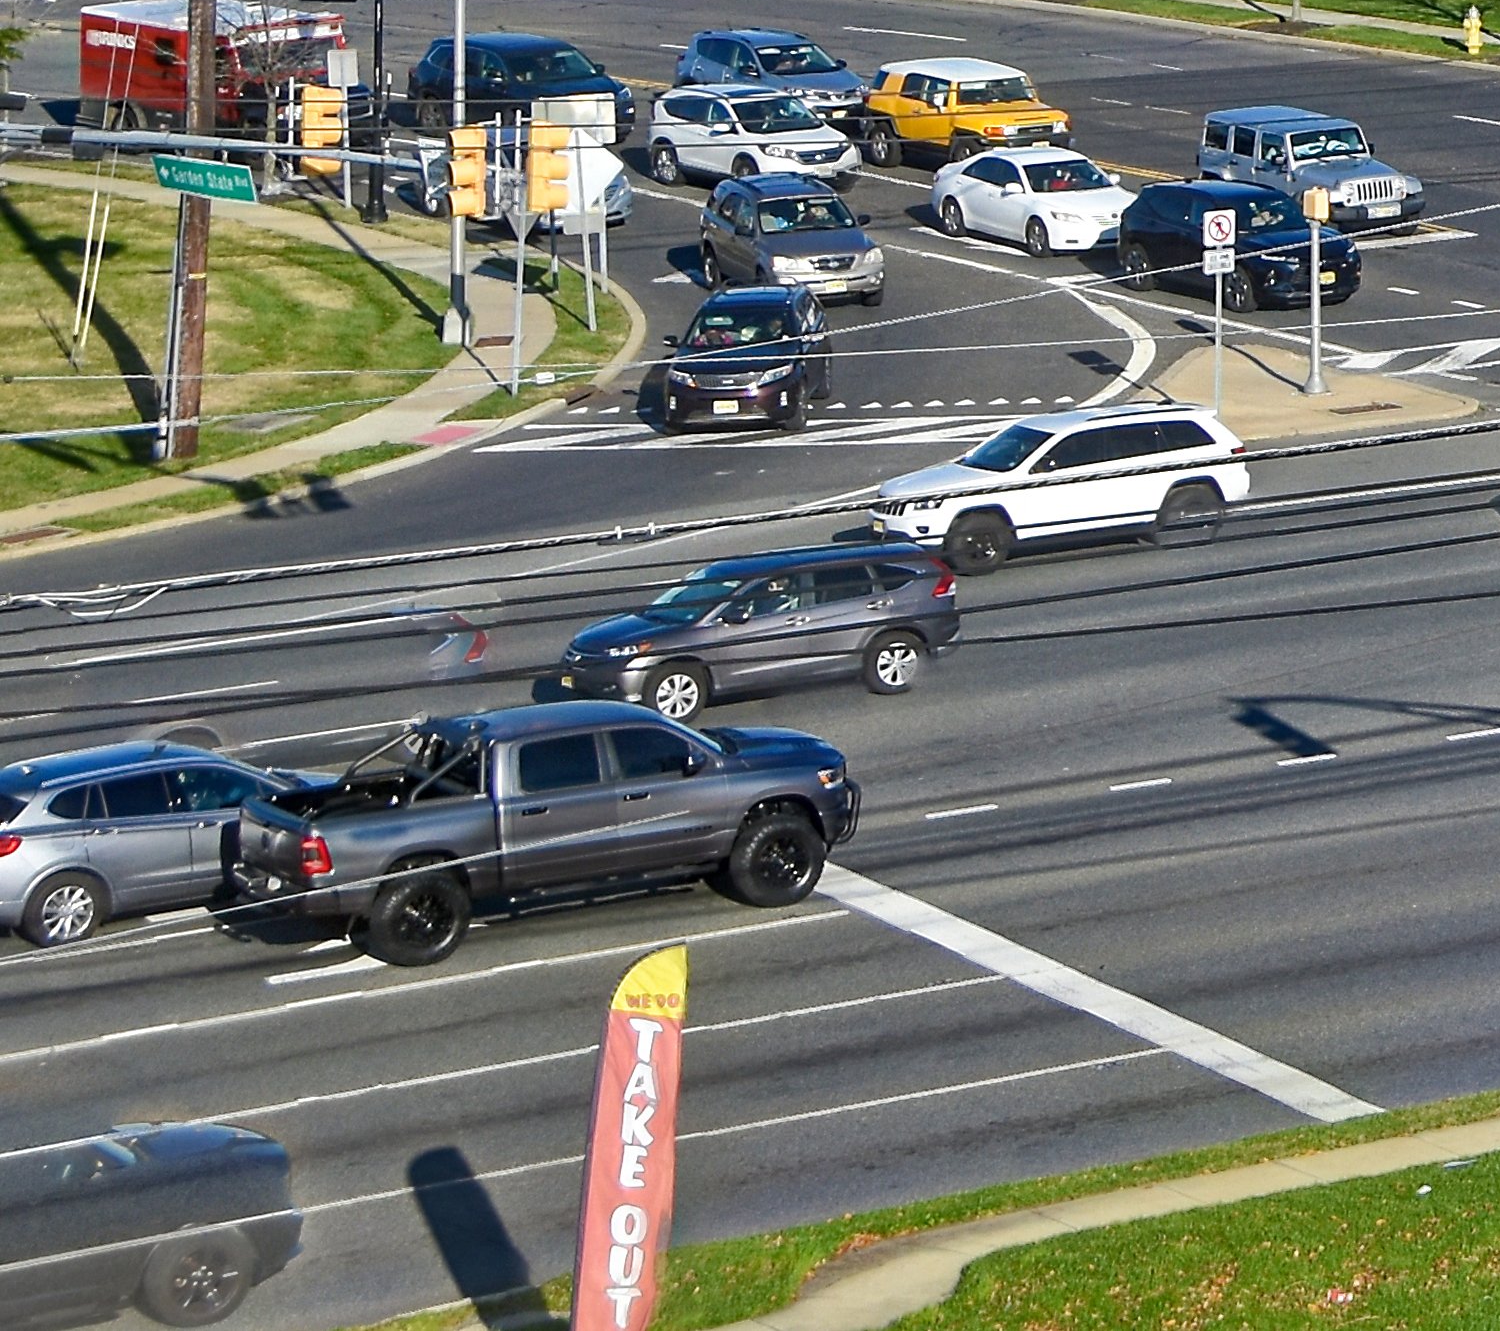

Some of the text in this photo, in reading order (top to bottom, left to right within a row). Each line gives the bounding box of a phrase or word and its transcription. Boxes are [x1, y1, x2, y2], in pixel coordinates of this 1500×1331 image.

[171, 166, 205, 187] Garden
[206, 171, 234, 191] State
[625, 992, 680, 1009] WE DO
[605, 1016, 664, 1330] TAKE OUT
